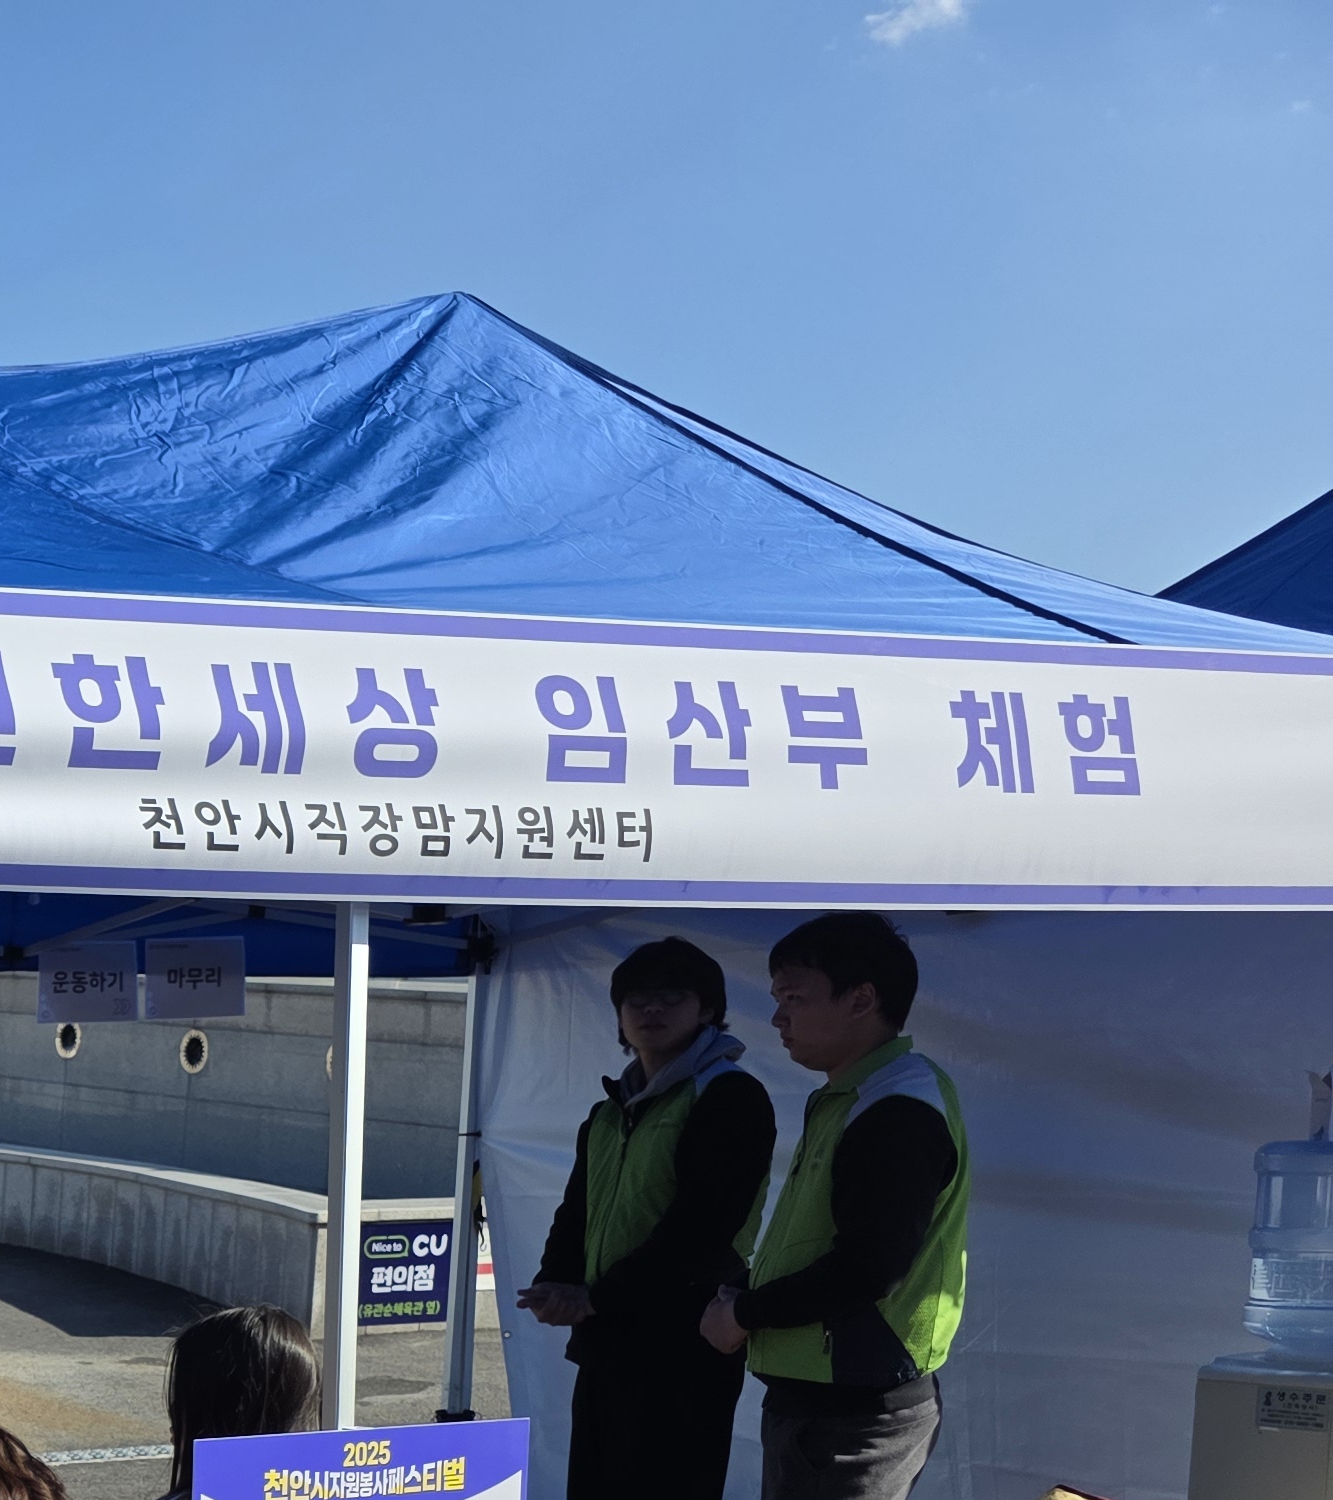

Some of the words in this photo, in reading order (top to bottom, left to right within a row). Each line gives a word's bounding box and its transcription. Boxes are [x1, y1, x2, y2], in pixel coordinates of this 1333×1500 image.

[532, 674, 871, 790] 임산부
[949, 690, 1142, 798] 체험
[138, 797, 658, 866] 천안시직장맘지원센터
[51, 970, 124, 994] 운동하기
[166, 966, 222, 990] 마무리
[371, 1242, 392, 1253] Nice
[393, 1241, 402, 1252] to
[412, 1233, 448, 1258] CU
[371, 1263, 435, 1294] 편의점
[342, 1440, 392, 1468] 2025
